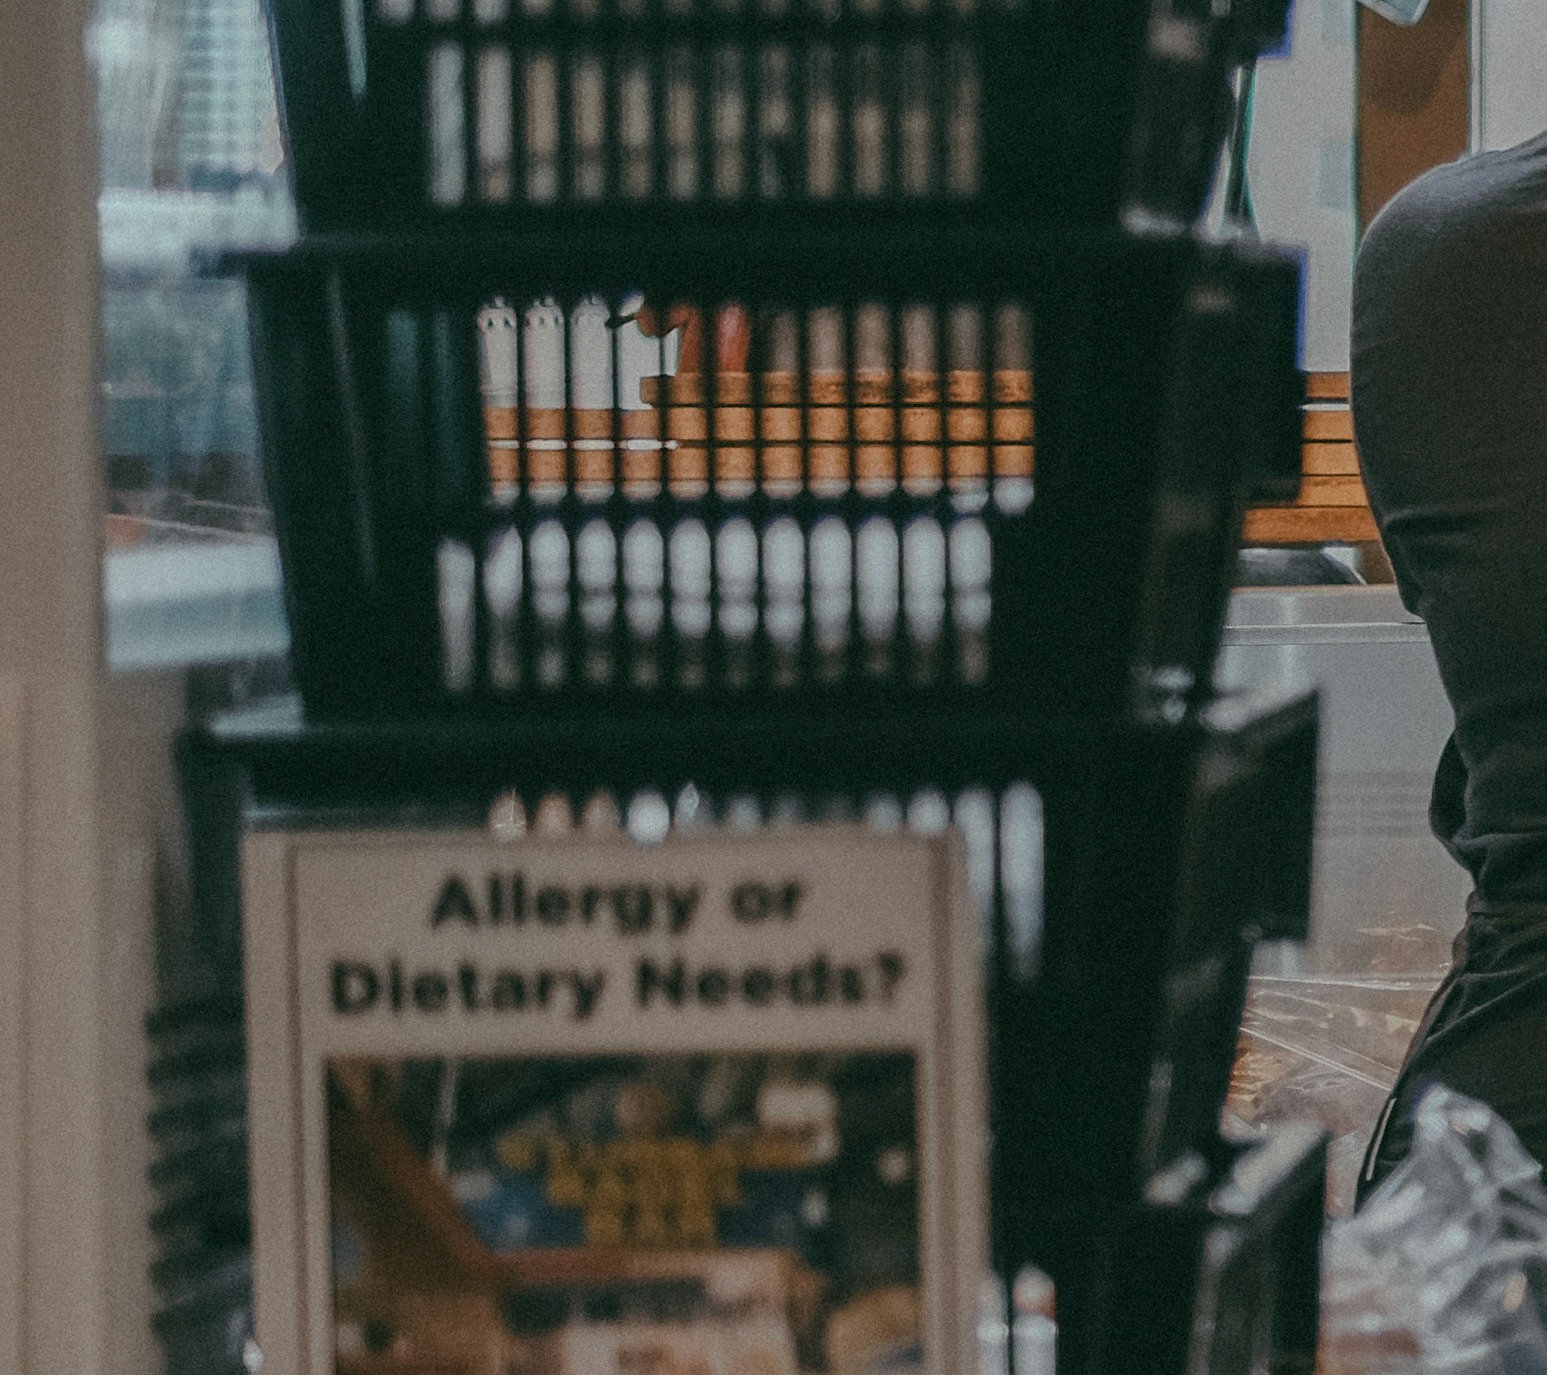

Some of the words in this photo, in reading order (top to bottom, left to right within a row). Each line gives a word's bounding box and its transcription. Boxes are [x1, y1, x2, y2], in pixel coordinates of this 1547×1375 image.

[428, 868, 703, 936] Allergy
[728, 878, 808, 923] or
[327, 957, 604, 1022] Dietary
[636, 951, 906, 1012] Needs?
